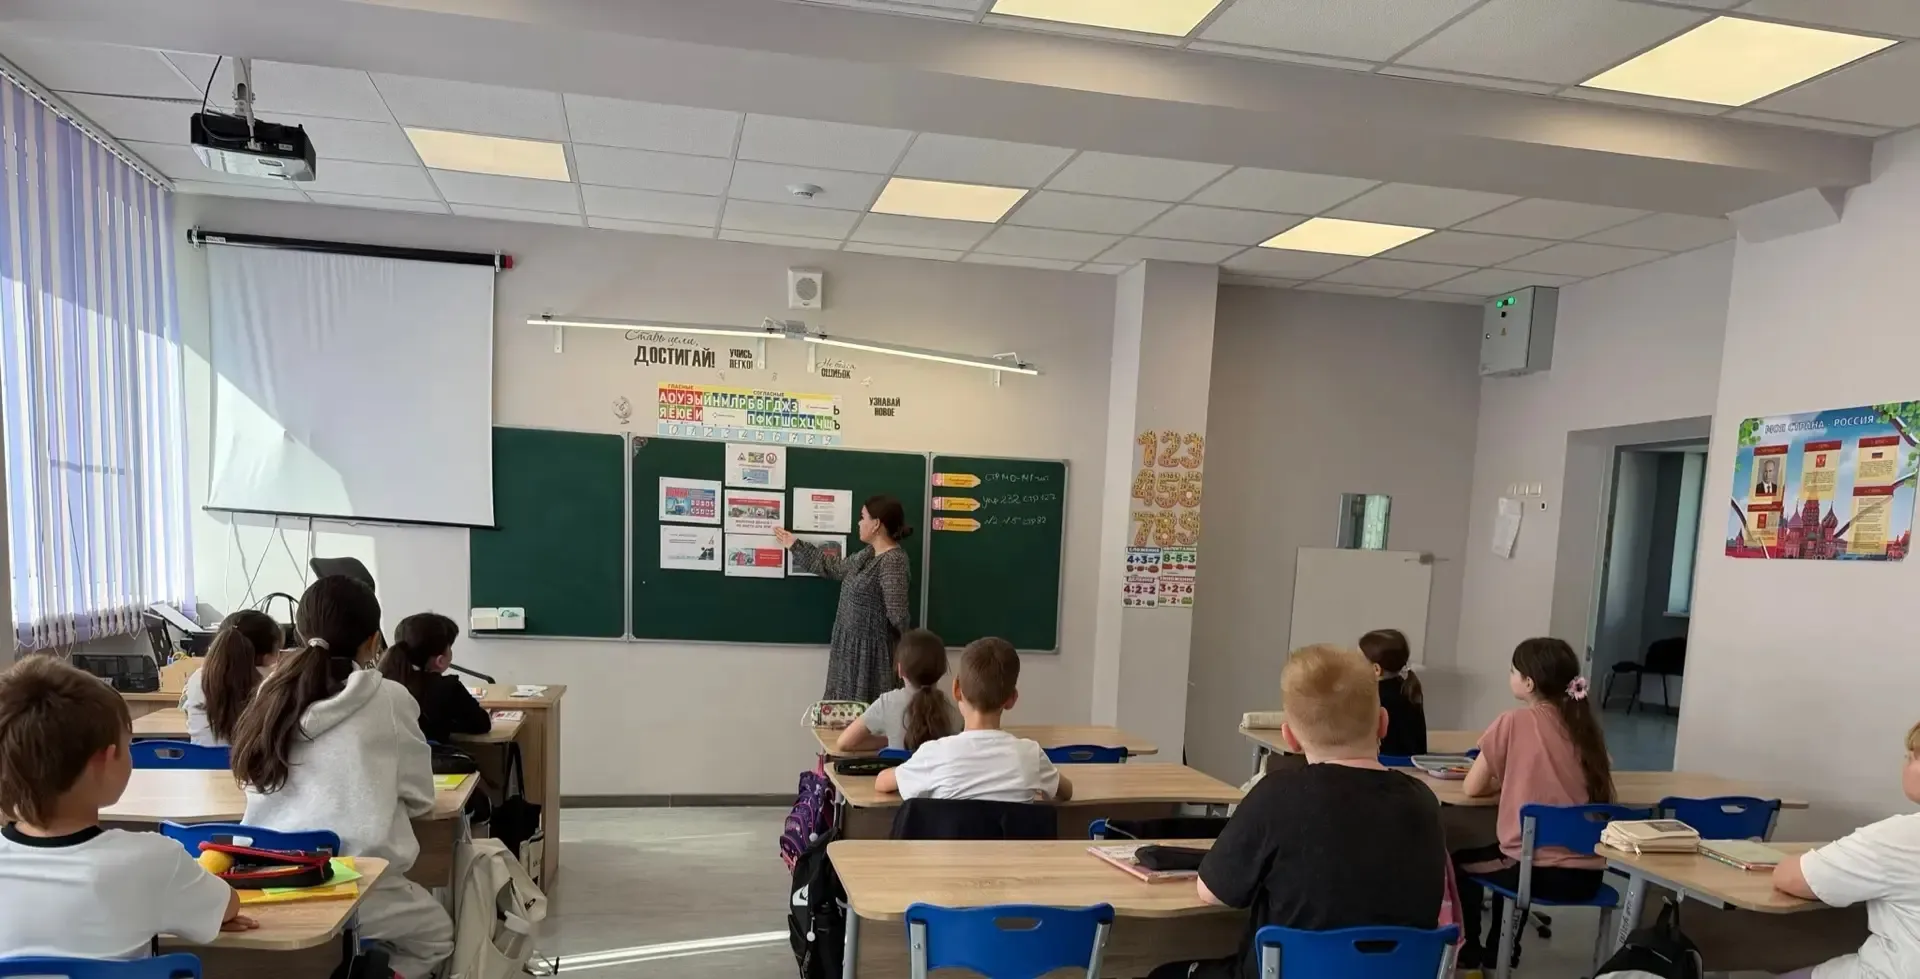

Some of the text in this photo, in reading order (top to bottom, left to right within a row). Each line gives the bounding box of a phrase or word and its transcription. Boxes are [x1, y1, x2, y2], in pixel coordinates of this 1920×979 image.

[634, 345, 715, 368] ДОСТИГАЙ!
[729, 348, 753, 359] УЧИСЬ
[729, 359, 753, 370] ЛЕГКО!
[821, 367, 851, 379] ОШИБОК
[869, 397, 901, 407] УЗНАВАЙ
[874, 407, 895, 417] НОВОЕ
[1788, 420, 1824, 432] СТРАНА
[1834, 415, 1874, 427] РОССИЯ
